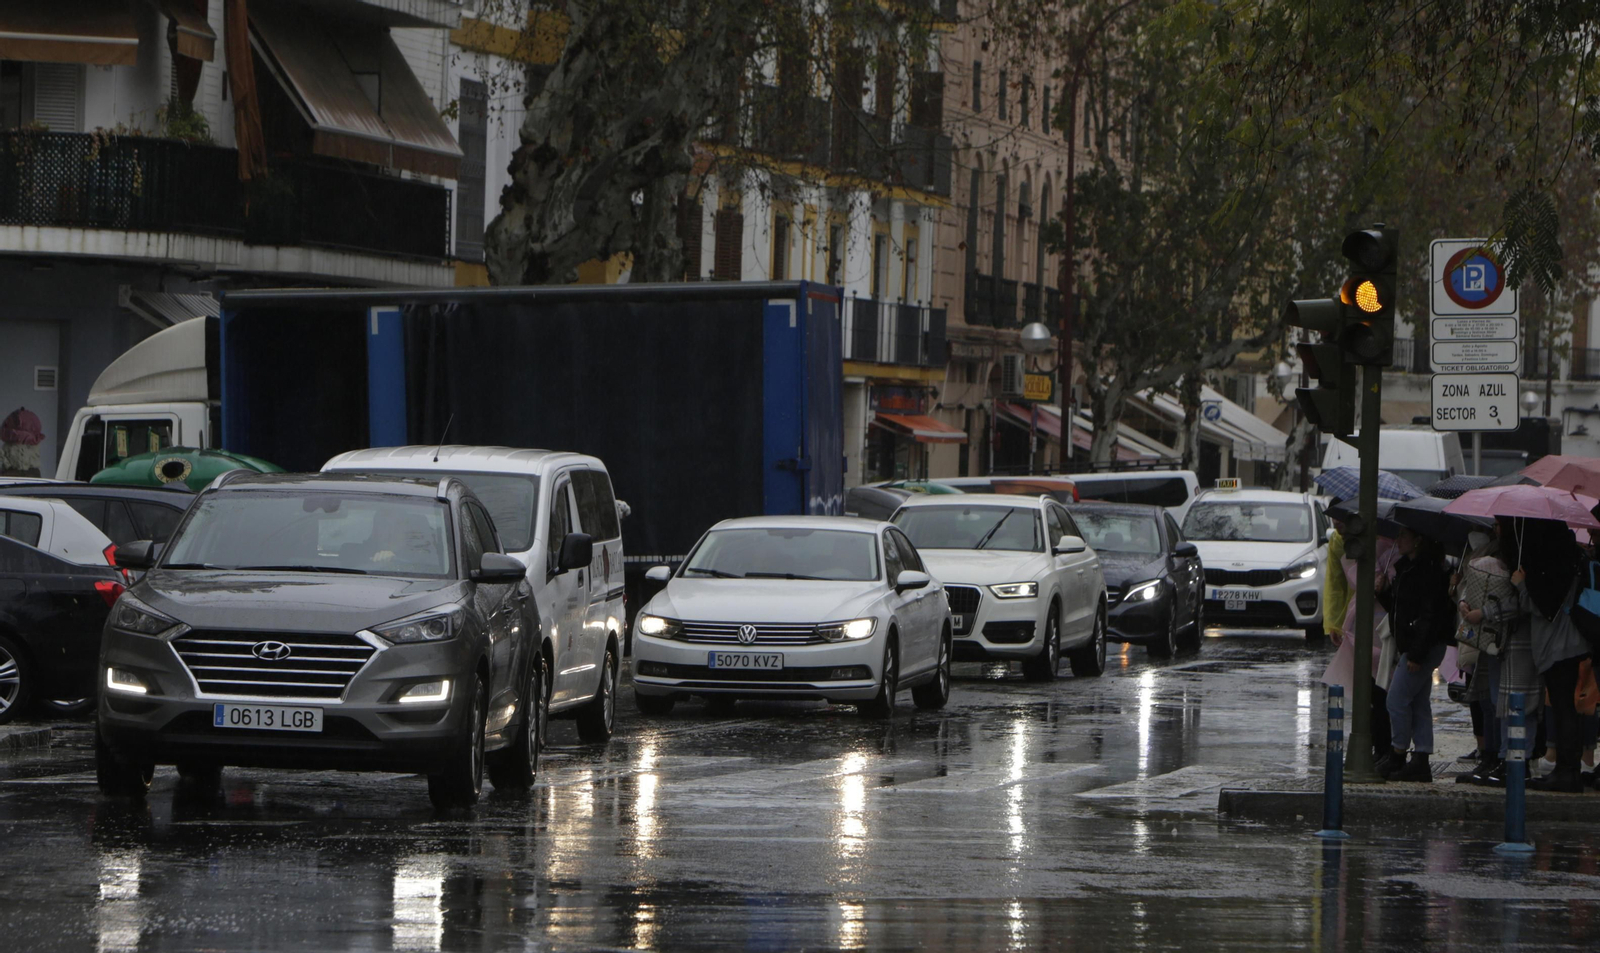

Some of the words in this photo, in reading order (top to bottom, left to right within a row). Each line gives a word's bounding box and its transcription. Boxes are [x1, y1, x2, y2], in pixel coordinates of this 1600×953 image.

[1442, 384, 1470, 397] ZONA
[1479, 383, 1506, 396] AZUL
[1436, 407, 1476, 420] SECTOR
[1489, 405, 1499, 417] 3
[1220, 479, 1233, 488] TAXI
[1218, 590, 1240, 600] 2278
[1243, 591, 1260, 600] KHV
[717, 654, 750, 668] 5070
[753, 655, 779, 668] KVZ
[230, 708, 274, 727] 0613
[281, 710, 315, 729] LGB
